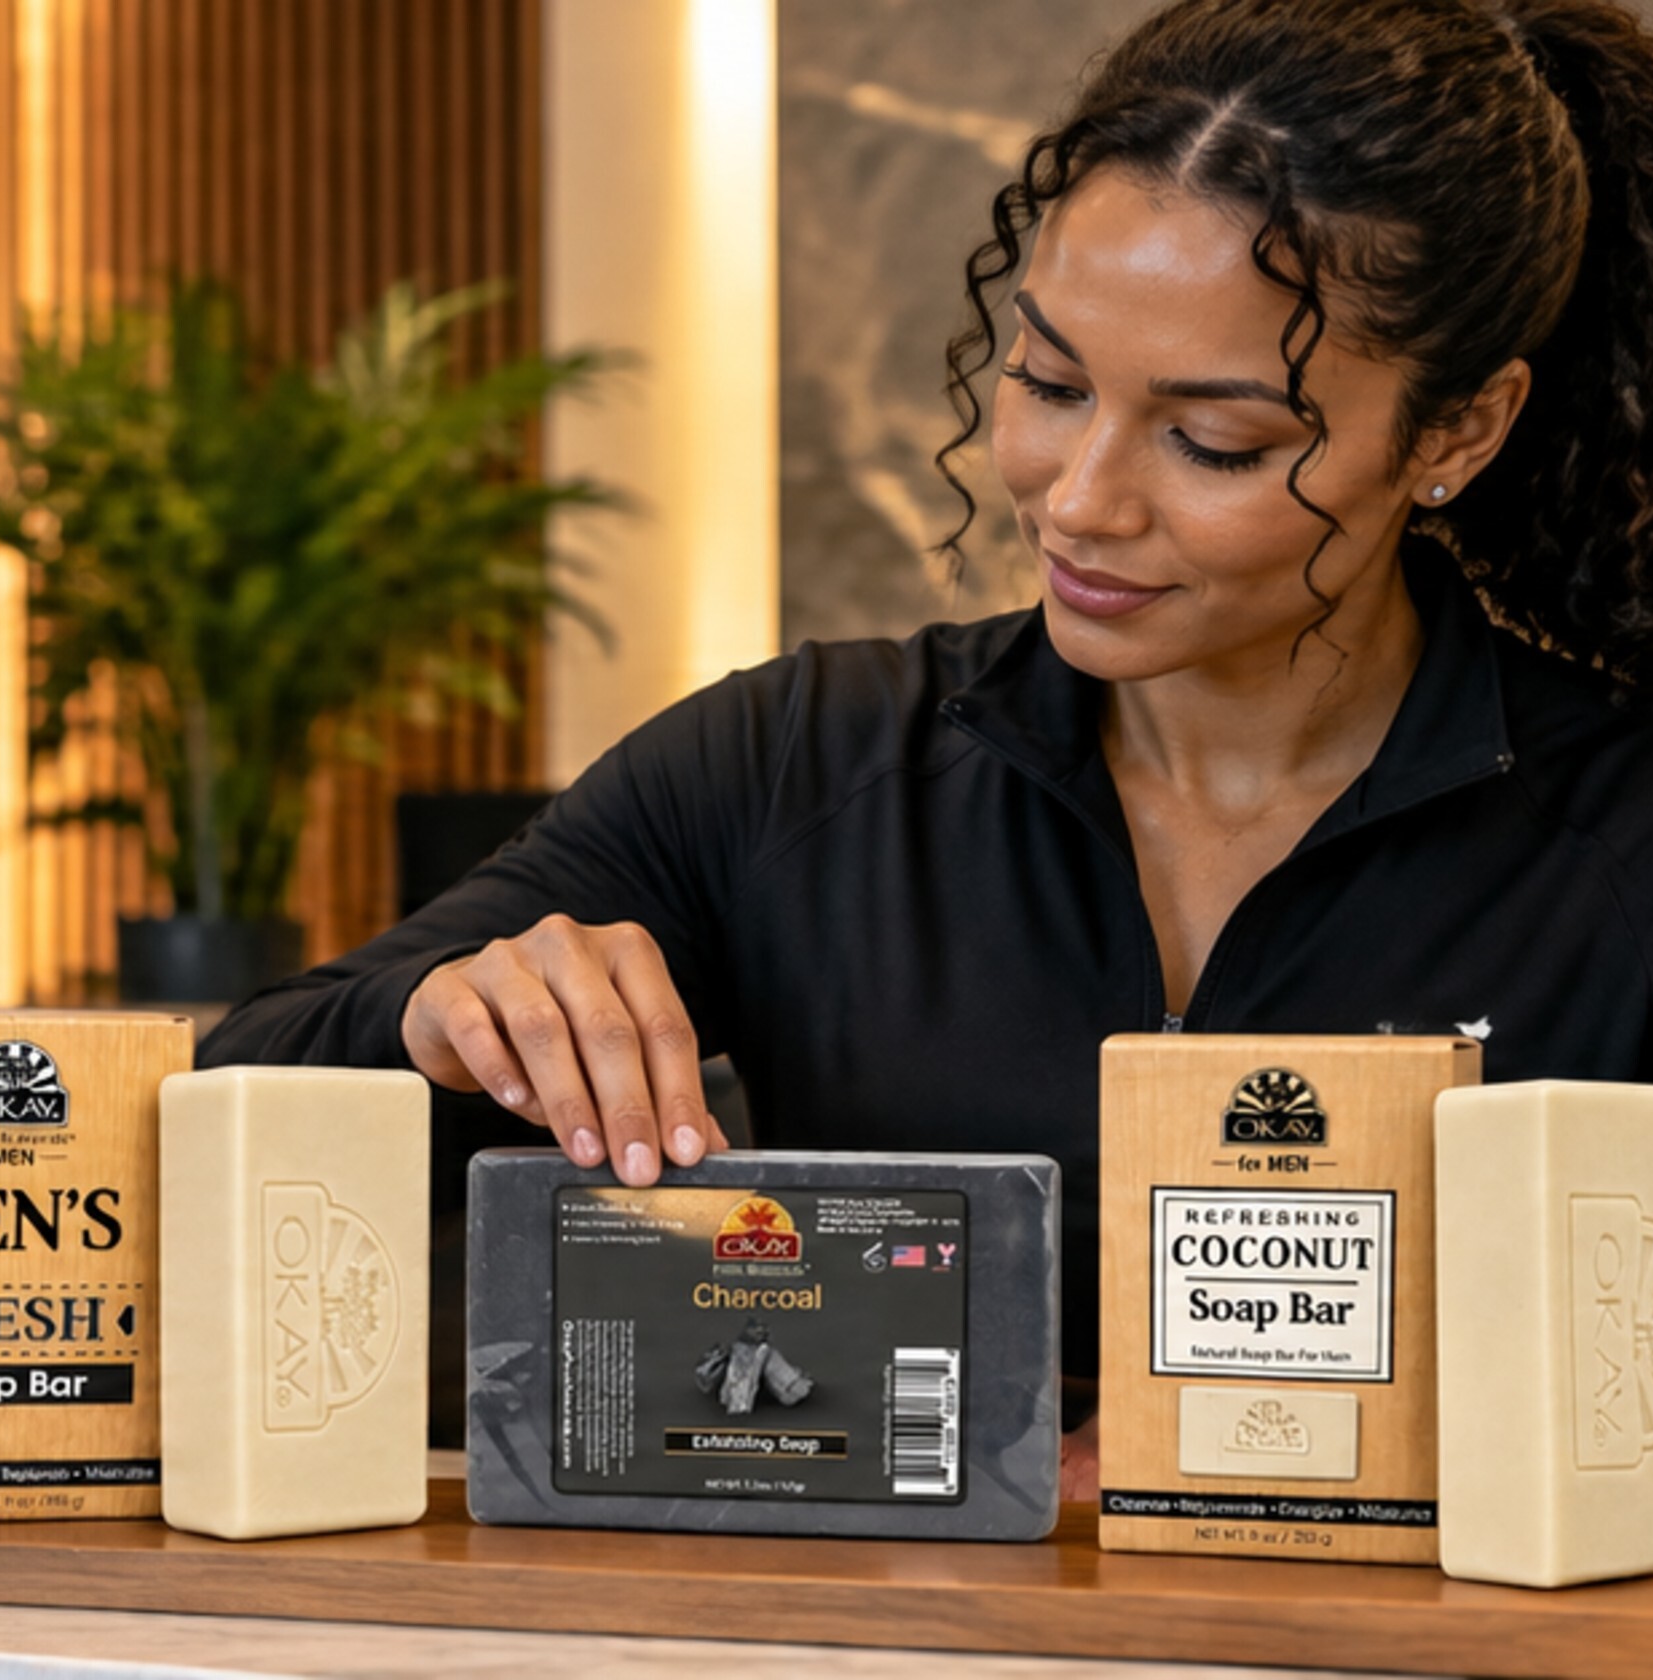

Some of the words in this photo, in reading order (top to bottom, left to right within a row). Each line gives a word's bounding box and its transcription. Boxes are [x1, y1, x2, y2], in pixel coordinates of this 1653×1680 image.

[1267, 1155, 1310, 1173] MEN
[1185, 1208, 1360, 1226] REFRESHING
[1171, 1233, 1374, 1270] COCONUT
[692, 1282, 822, 1310] Charcoal
[1189, 1288, 1279, 1333] Soap
[1289, 1291, 1355, 1325] Bar
[28, 1369, 89, 1398] Bar
